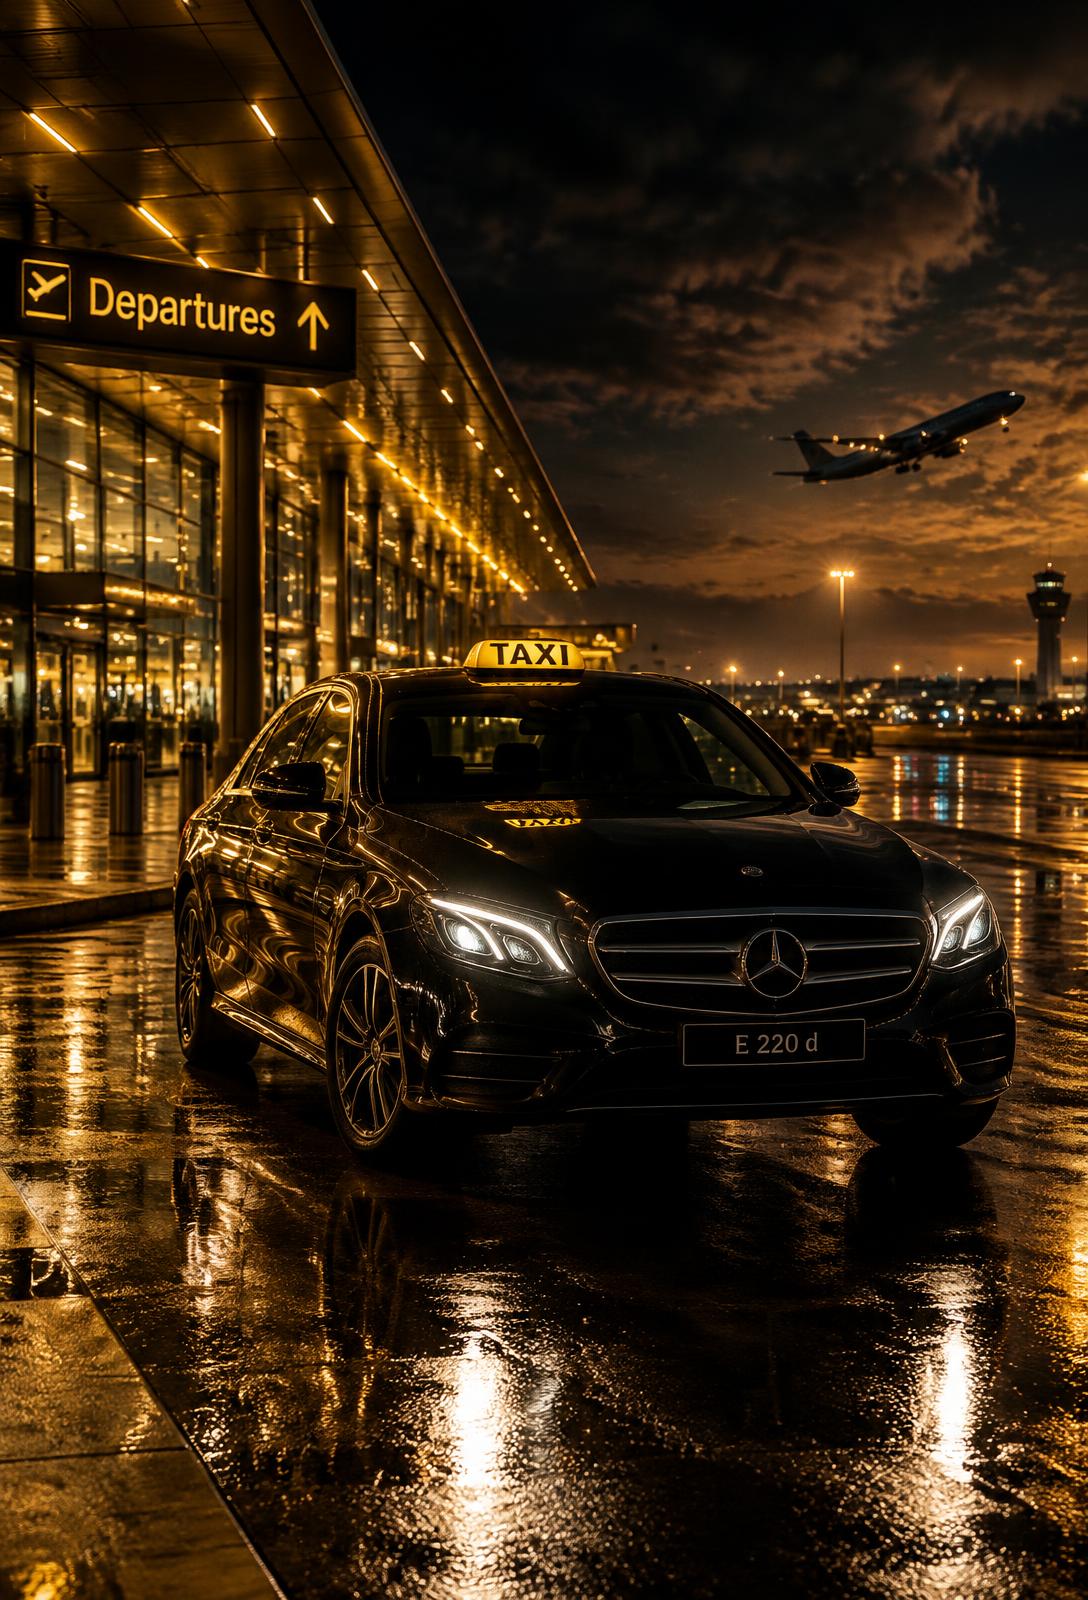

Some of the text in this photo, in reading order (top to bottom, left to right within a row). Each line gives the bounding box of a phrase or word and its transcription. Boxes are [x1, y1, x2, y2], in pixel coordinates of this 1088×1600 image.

[89, 277, 276, 338] Departures
[490, 643, 569, 666] TAXI
[735, 1032, 818, 1055] E 220 d
